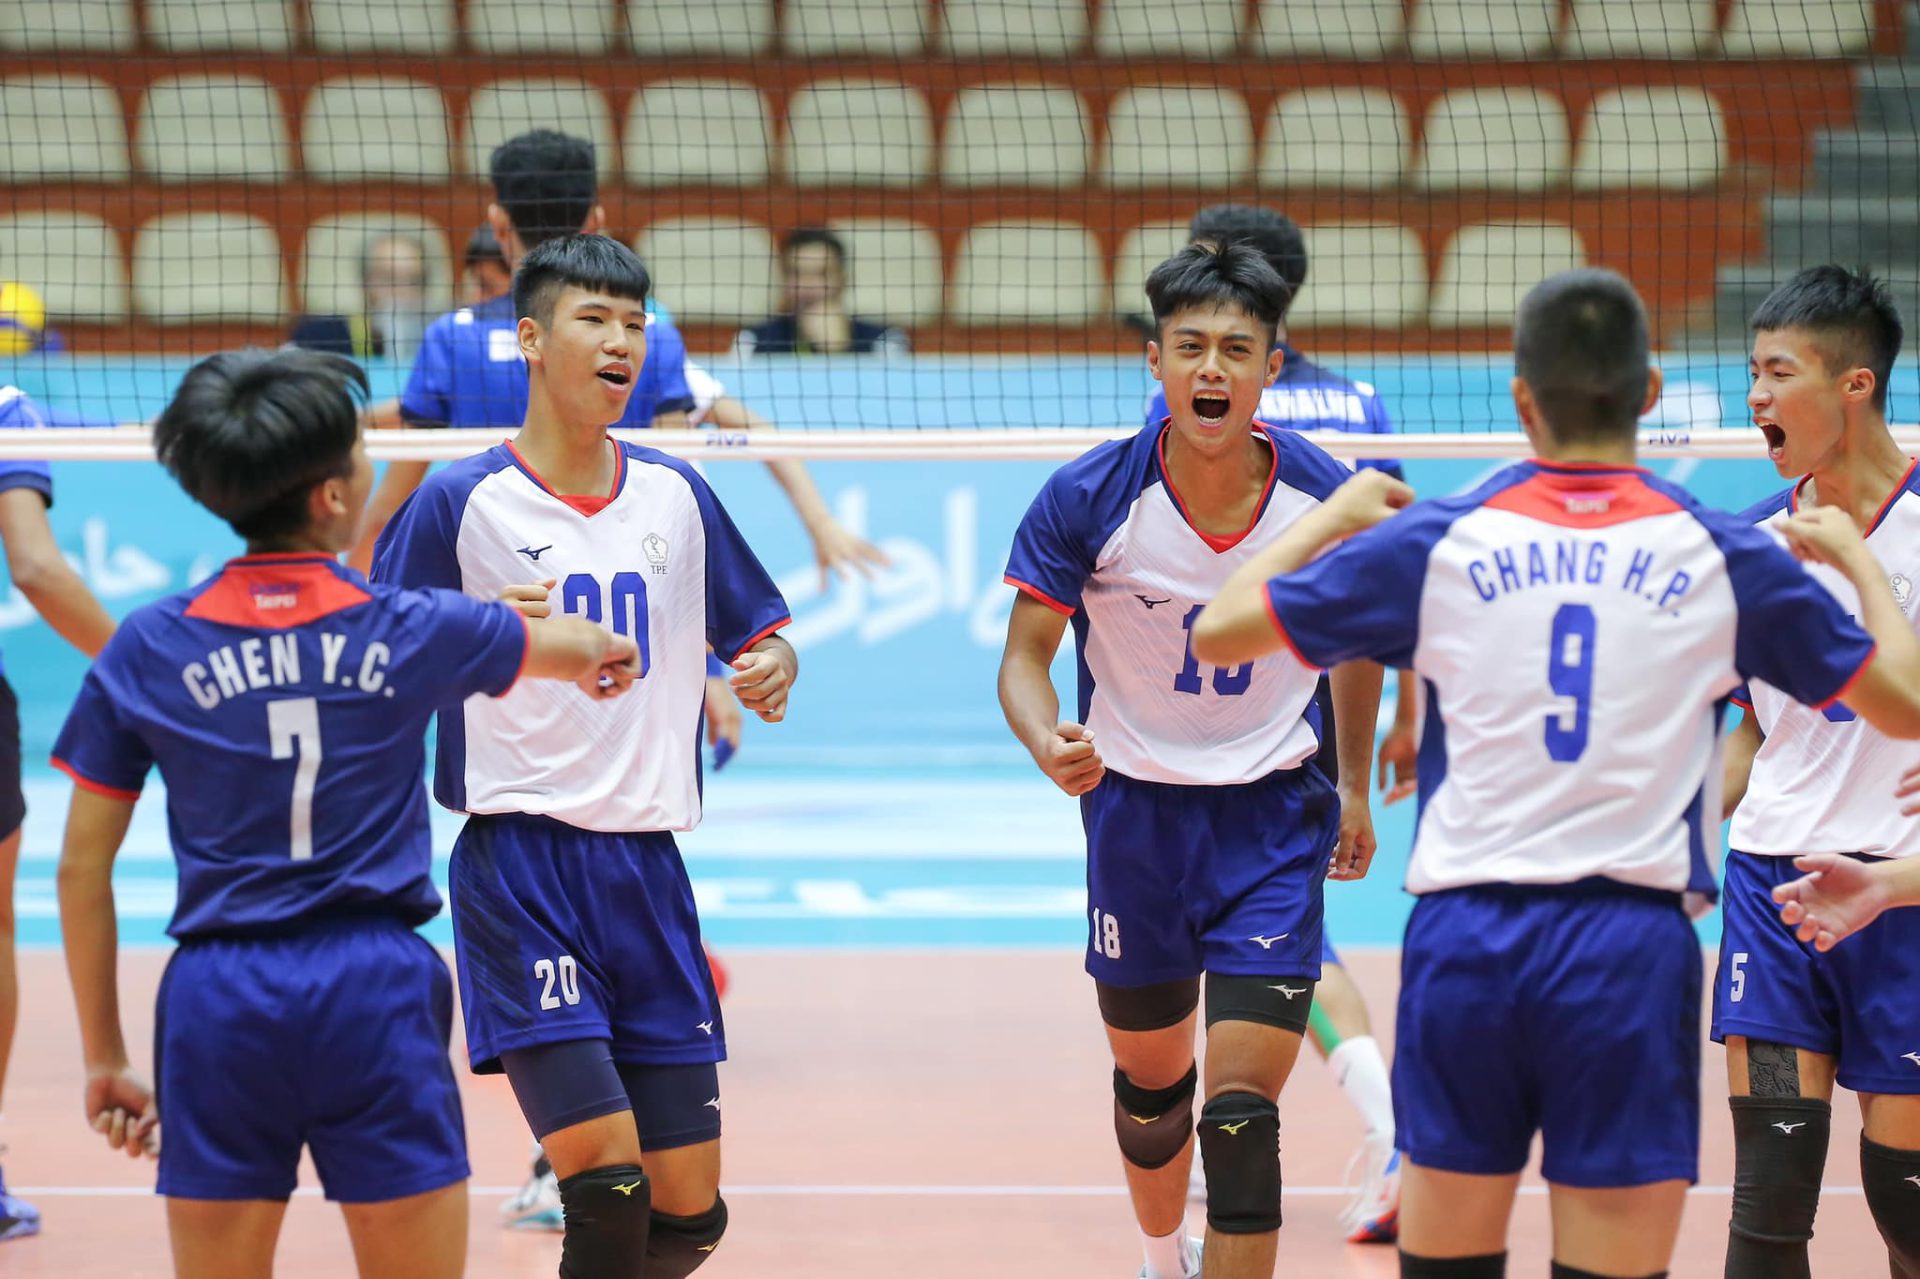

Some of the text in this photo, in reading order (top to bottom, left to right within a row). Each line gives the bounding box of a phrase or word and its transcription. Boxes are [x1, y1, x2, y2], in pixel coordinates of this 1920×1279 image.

[650, 565, 668, 575] TPE
[1468, 540, 1691, 618] CHANG H.P.
[181, 632, 396, 710] CHEN Y.C.
[1544, 602, 1597, 763] 9
[266, 696, 323, 862] 7
[1093, 906, 1122, 959] 18
[533, 954, 581, 1011] 20
[1730, 952, 1749, 1003] 5
